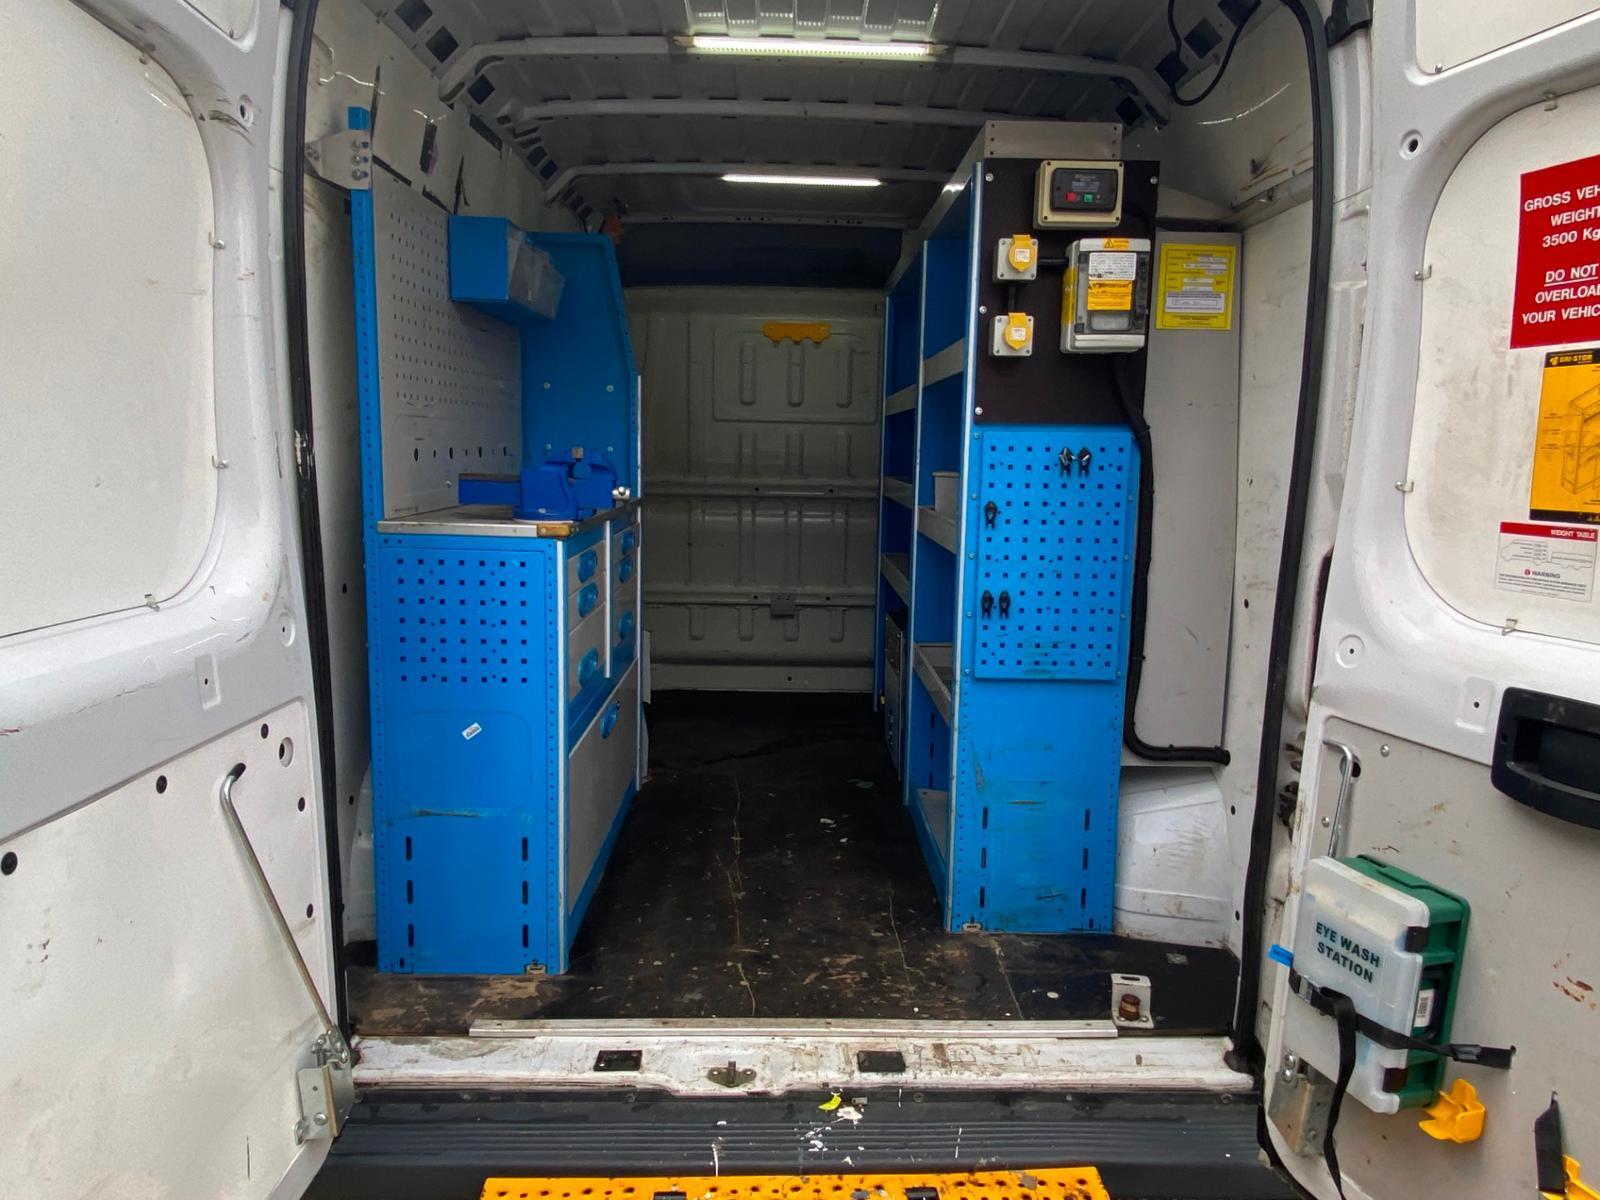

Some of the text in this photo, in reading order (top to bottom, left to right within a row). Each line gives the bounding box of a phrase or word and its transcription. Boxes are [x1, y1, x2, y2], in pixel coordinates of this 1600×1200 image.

[1524, 191, 1571, 212] GROSS
[1551, 205, 1600, 227] WEIGHT
[1542, 230, 1578, 248] 3500
[1545, 263, 1600, 283] DO NOT
[1522, 309, 1556, 325] YOUR
[1550, 529, 1596, 539] WEIGHT TABLE
[1315, 921, 1380, 968] EYE WASH
[1317, 941, 1373, 983] STATION
